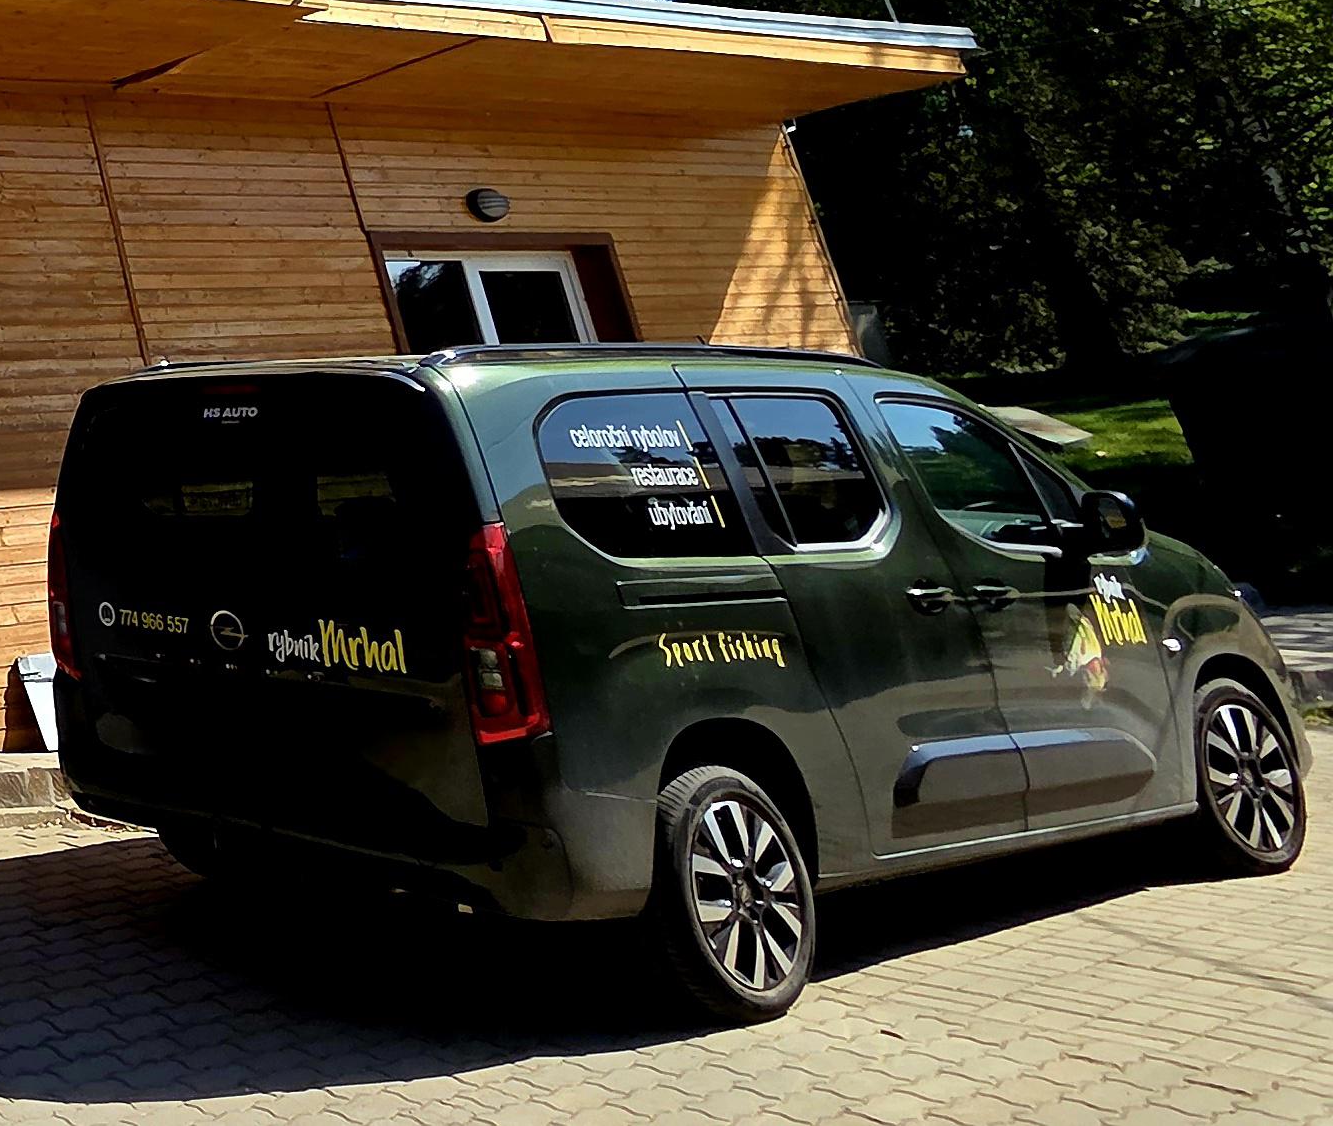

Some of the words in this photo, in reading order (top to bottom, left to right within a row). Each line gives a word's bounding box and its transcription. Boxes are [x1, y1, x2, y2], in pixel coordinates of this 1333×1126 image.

[203, 407, 221, 419] HS
[222, 406, 259, 418] AUTO
[569, 424, 633, 448] celoroční
[630, 425, 682, 452] rybolov
[630, 463, 699, 487] restaurace
[648, 500, 714, 531] ubytování
[118, 608, 139, 627] 774
[141, 611, 164, 631] 966
[166, 615, 190, 634] 557
[317, 618, 408, 674] Mrhal
[658, 632, 715, 668] Sport
